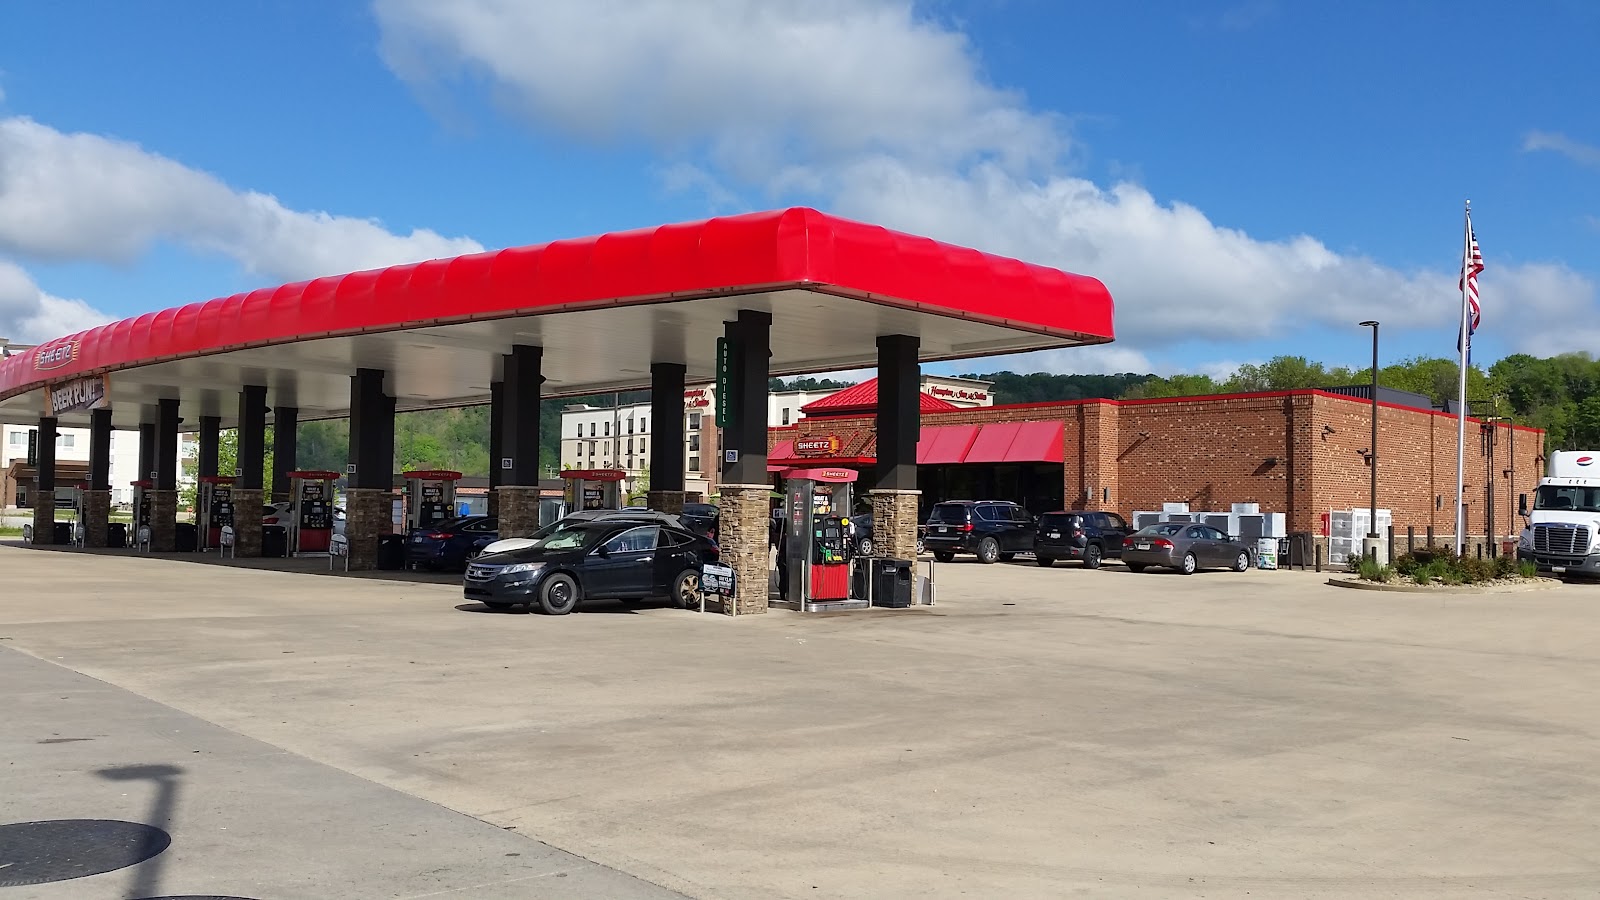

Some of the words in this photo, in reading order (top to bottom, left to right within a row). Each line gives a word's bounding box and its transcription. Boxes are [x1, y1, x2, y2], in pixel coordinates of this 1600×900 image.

[40, 344, 71, 364] SHEETZ
[52, 387, 73, 412] BEER
[74, 379, 95, 404] RUN!
[798, 441, 830, 450] SHEETZ
